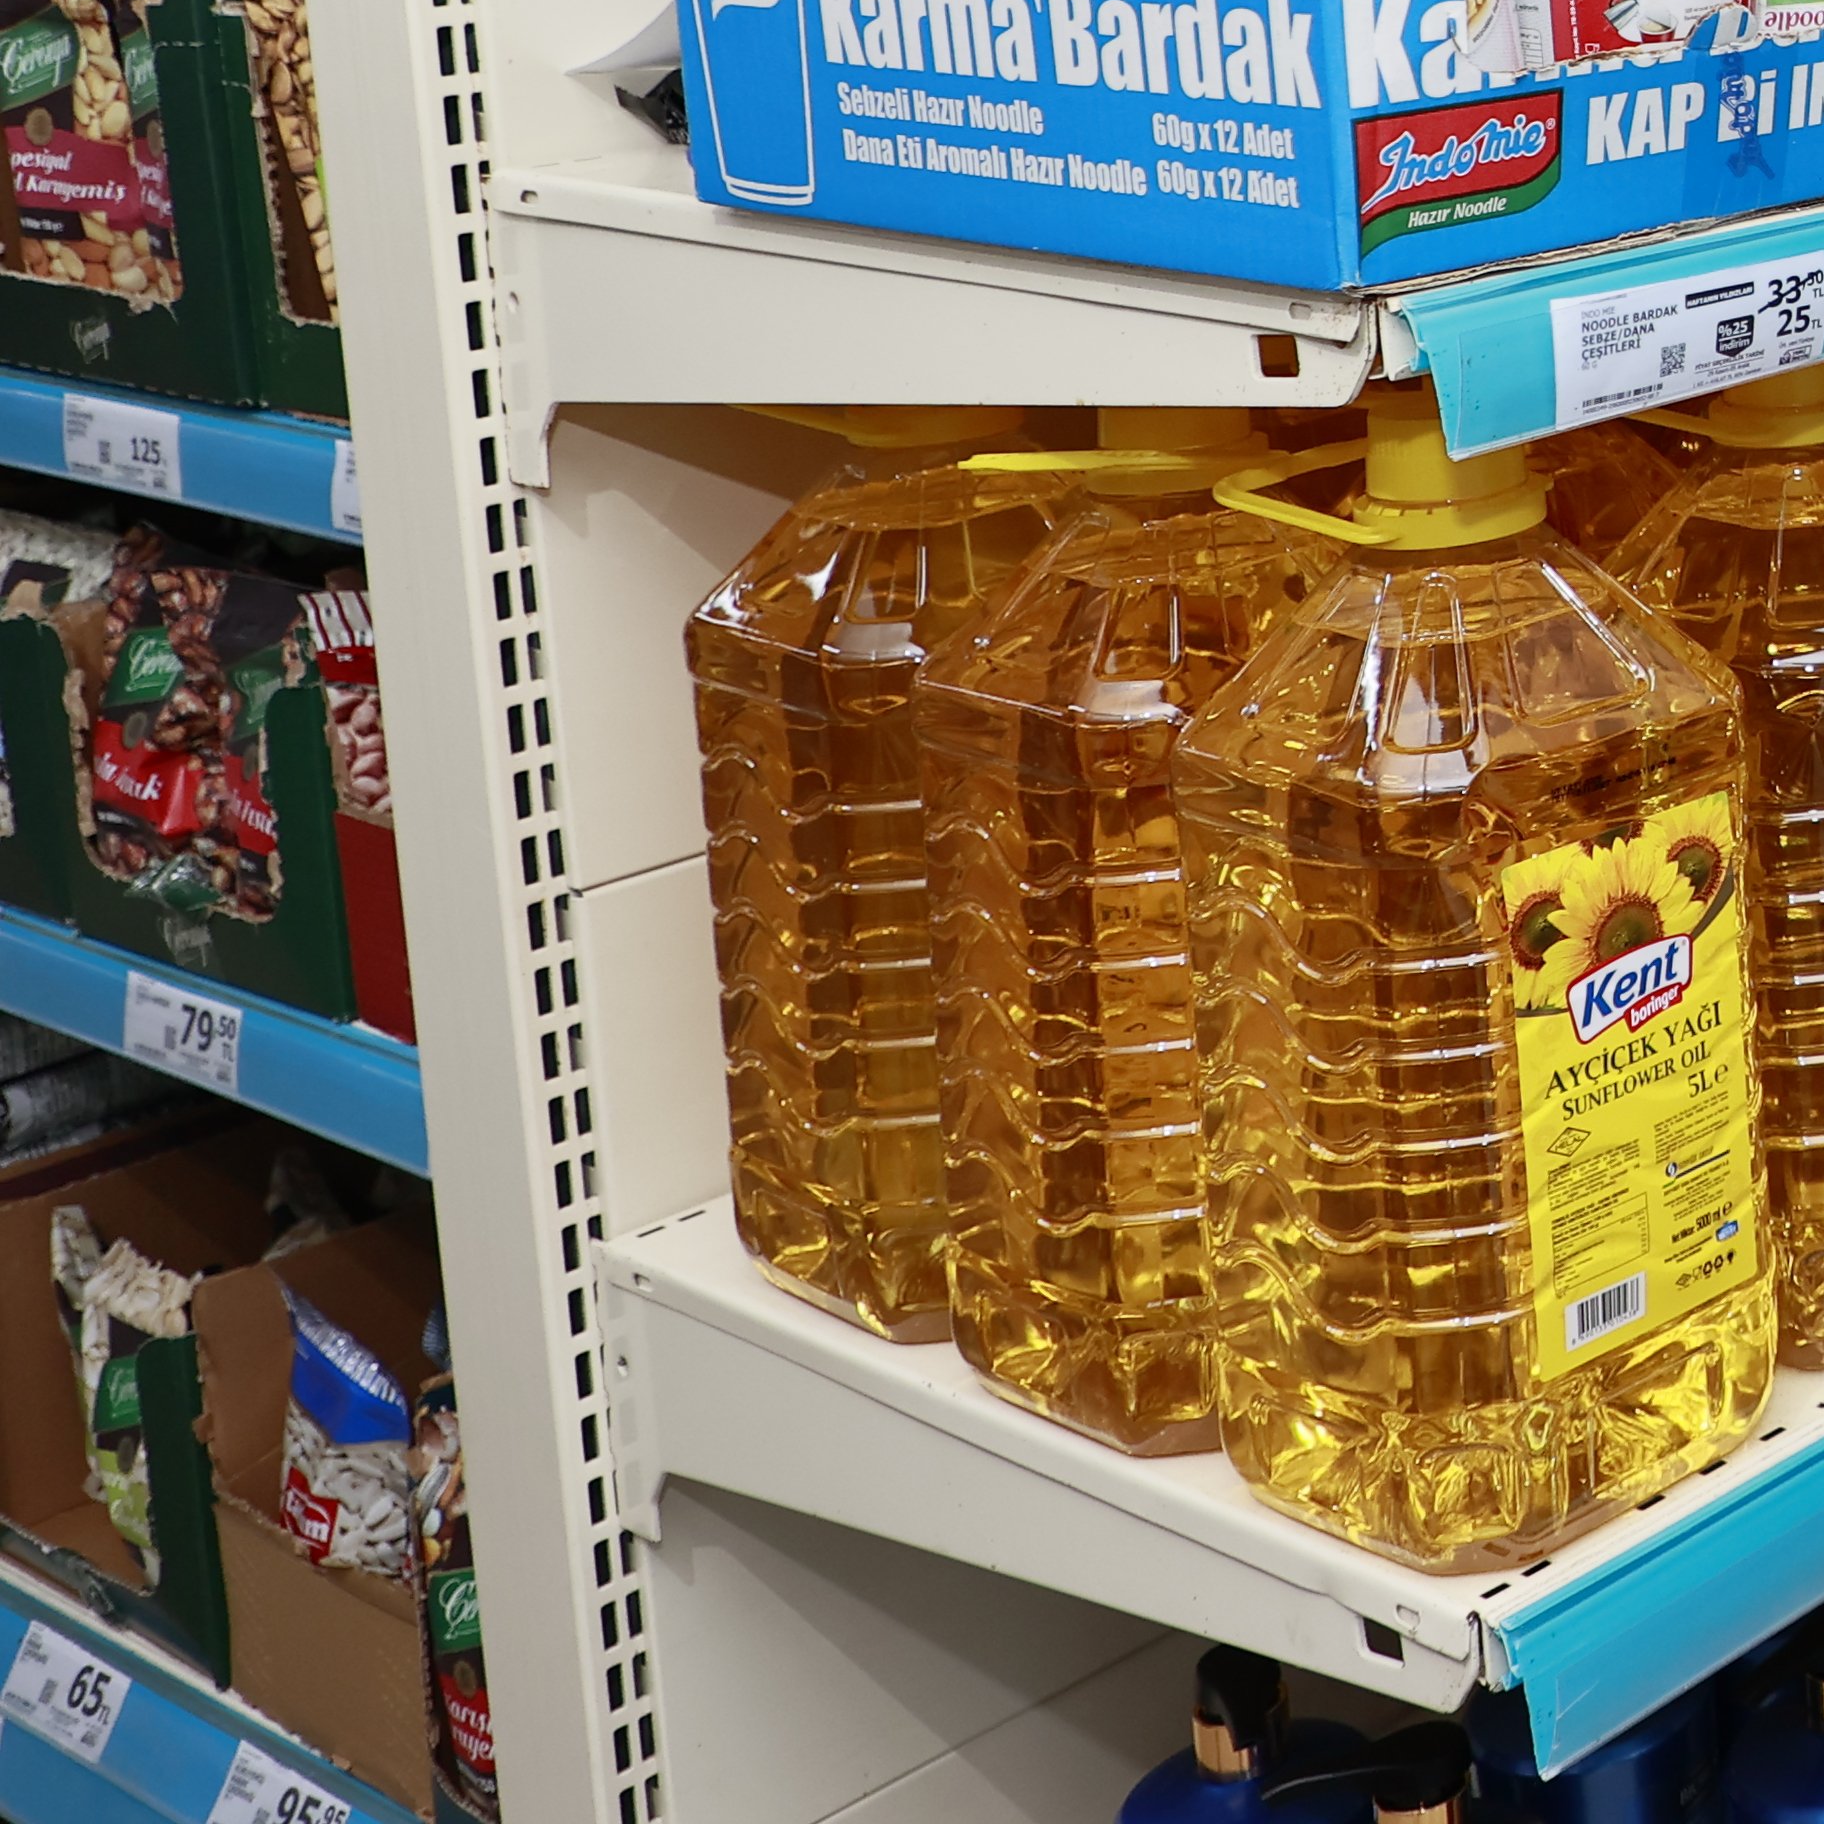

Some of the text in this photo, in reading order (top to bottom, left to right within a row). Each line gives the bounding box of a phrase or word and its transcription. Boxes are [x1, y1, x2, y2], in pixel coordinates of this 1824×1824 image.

[837, 80, 1045, 136] Sebzeli Hazır Noodle
[1585, 82, 1702, 166] KAP
[1152, 112, 1296, 159] 60g x 12 Adet
[10, 149, 73, 178] pesiyal
[843, 128, 1148, 198] Dana Eti Aromalı Hazır Noodle
[1157, 159, 1300, 208] 60g x 12 Adet
[1407, 194, 1508, 230] Hazır Noodle
[1581, 304, 1679, 334] NOODLE BARDAK
[1581, 323, 1655, 348] SEBZE/DANA
[1718, 319, 1749, 337] %25
[1777, 305, 1811, 337] 25
[1581, 337, 1641, 363] ÇEŞİTLERİ
[1718, 337, 1751, 353] indirim
[130, 437, 162, 465] 125
[1581, 941, 1681, 1030] Kent
[1629, 982, 1681, 1028] boringer
[1545, 999, 1724, 1101] AYÇİÇEK YAĞI
[1561, 1039, 1712, 1122] SUNFLOWER OIL
[67, 1664, 111, 1717] 65
